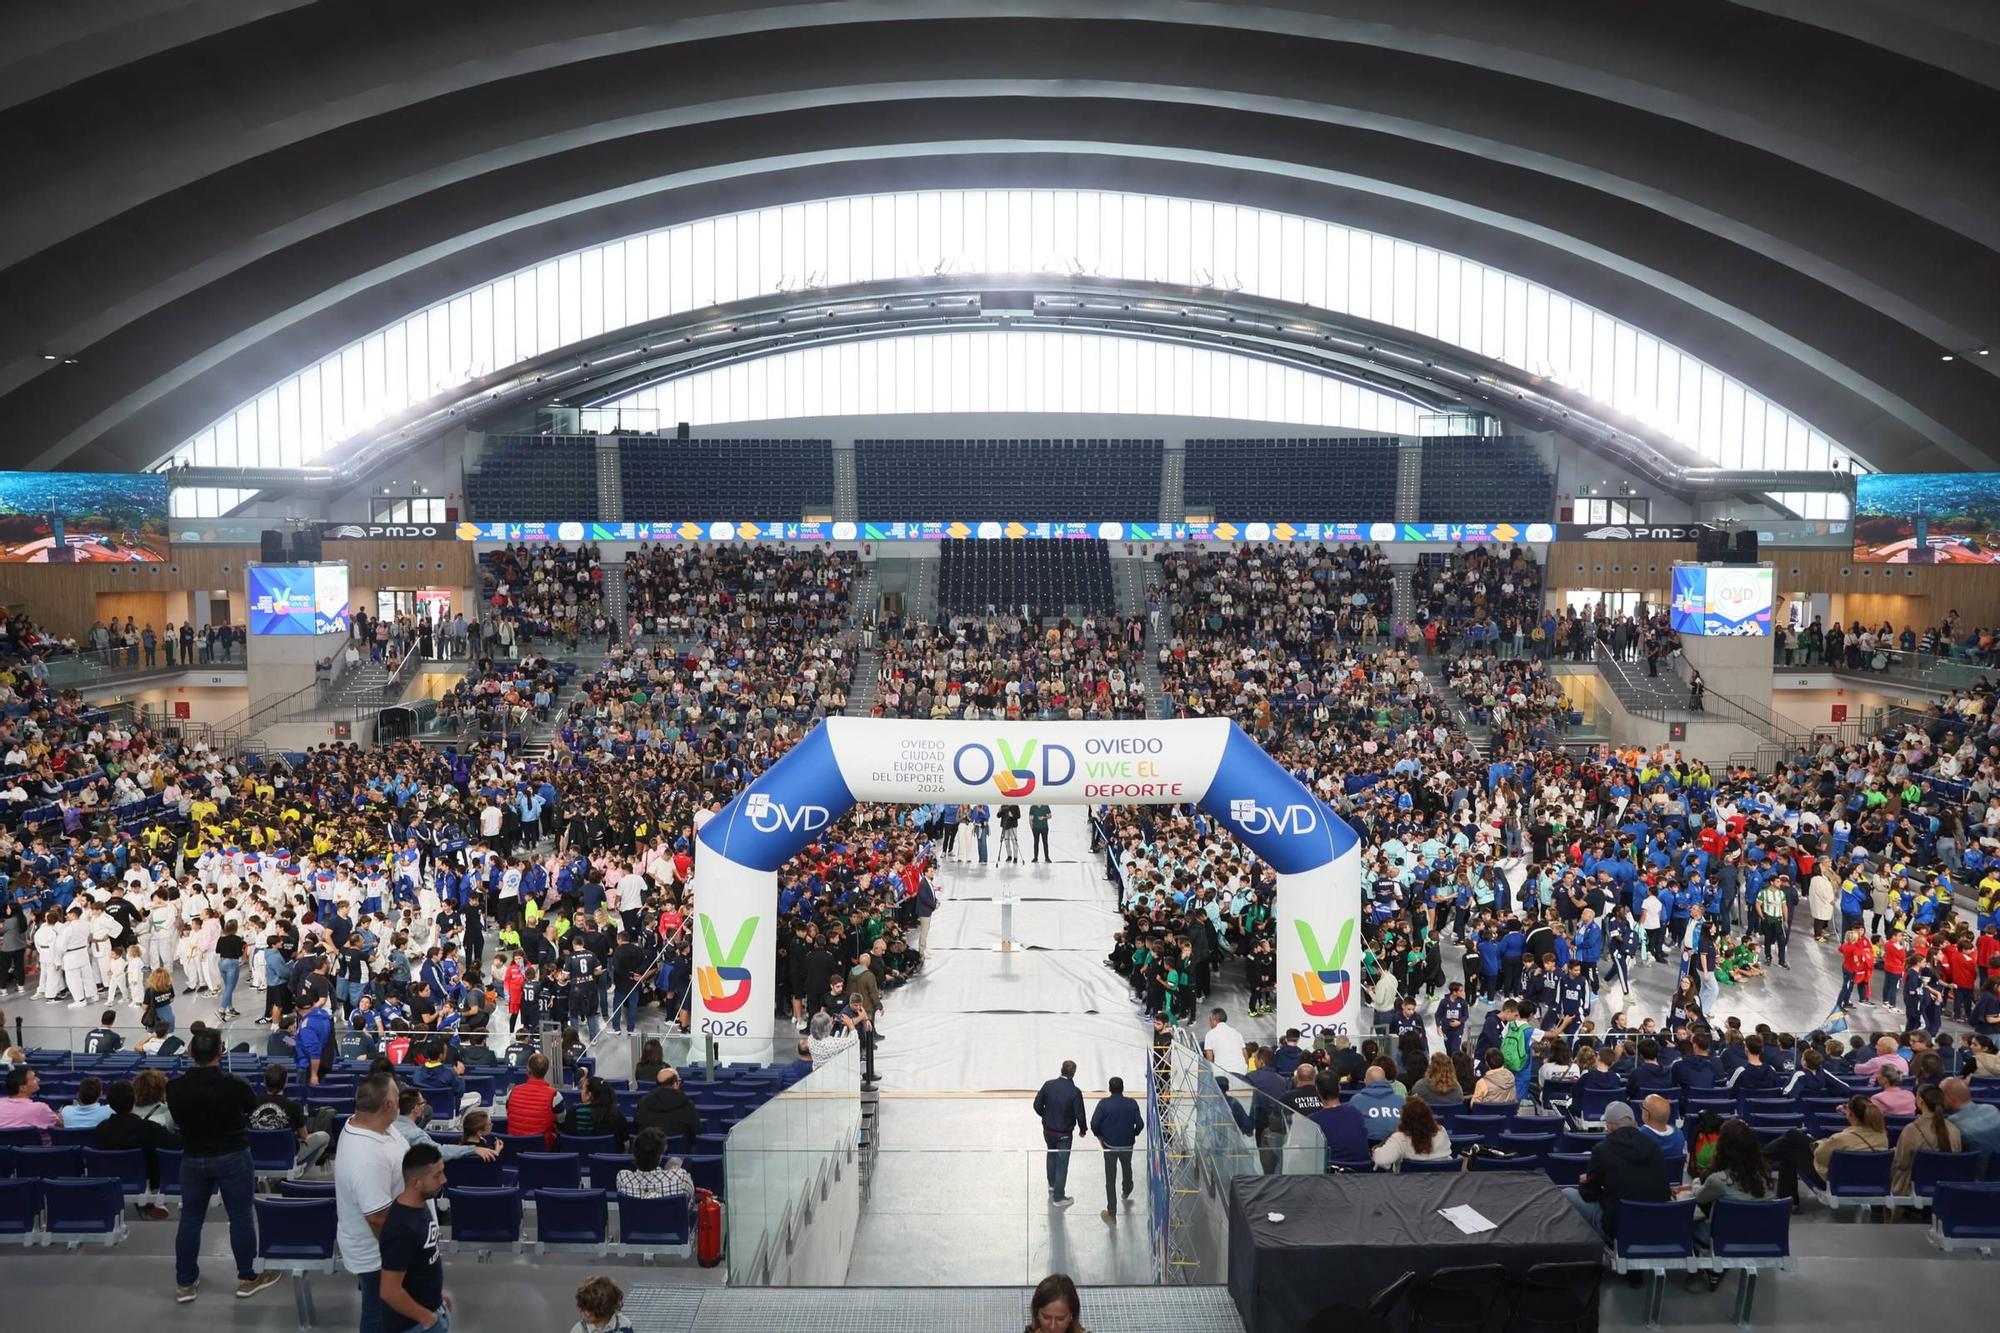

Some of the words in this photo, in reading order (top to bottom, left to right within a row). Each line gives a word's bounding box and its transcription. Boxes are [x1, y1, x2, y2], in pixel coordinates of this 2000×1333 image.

[369, 526, 437, 537] PMDO
[1635, 528, 1700, 539] PMDO
[901, 739, 945, 750] OVIEDO
[1085, 738, 1163, 755] OVIEDO
[901, 750, 945, 761] CIUDAD
[893, 761, 945, 773] EUROPEA
[953, 738, 1076, 798] OVD
[1085, 761, 1133, 779] VIVE
[1138, 761, 1160, 778] EL
[872, 772, 893, 781] DEL
[896, 773, 944, 784] DEPORTE
[917, 784, 945, 793] 2026
[1085, 783, 1183, 798] DEPORTE
[752, 801, 830, 833] OVD
[1240, 804, 1317, 836] OVD
[701, 1017, 748, 1037] 2026
